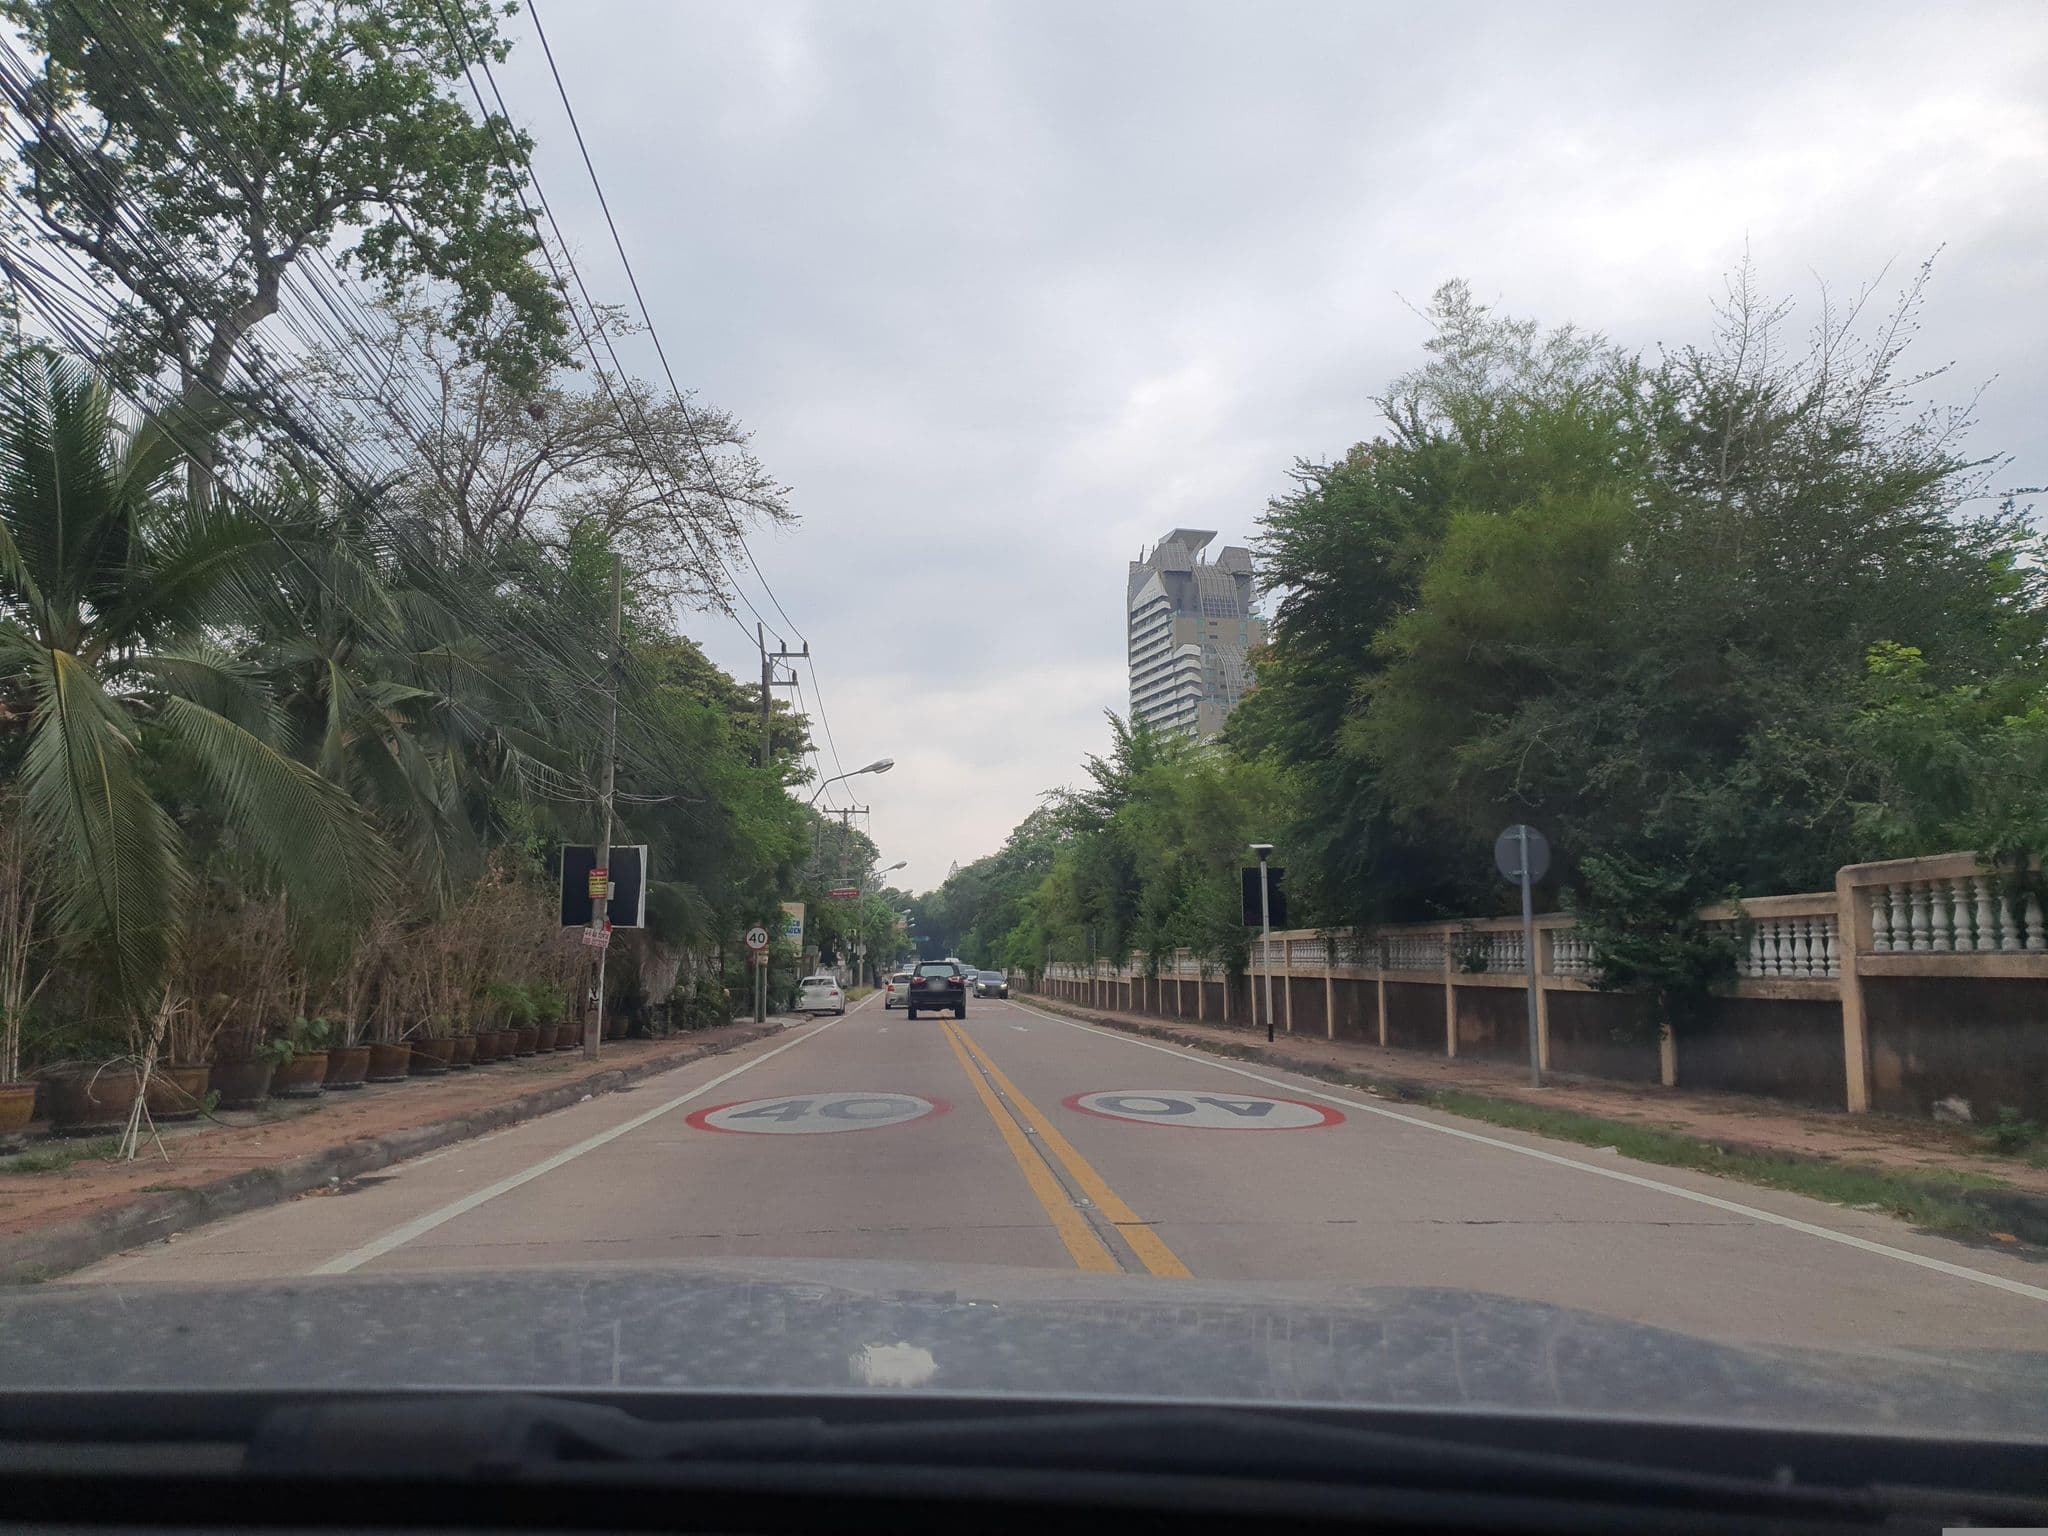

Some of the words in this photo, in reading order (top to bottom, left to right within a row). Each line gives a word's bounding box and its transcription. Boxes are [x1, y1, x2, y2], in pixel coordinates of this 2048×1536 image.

[749, 933, 765, 943] 40
[728, 1099, 917, 1121] 40
[1095, 1096, 1275, 1117] 40
